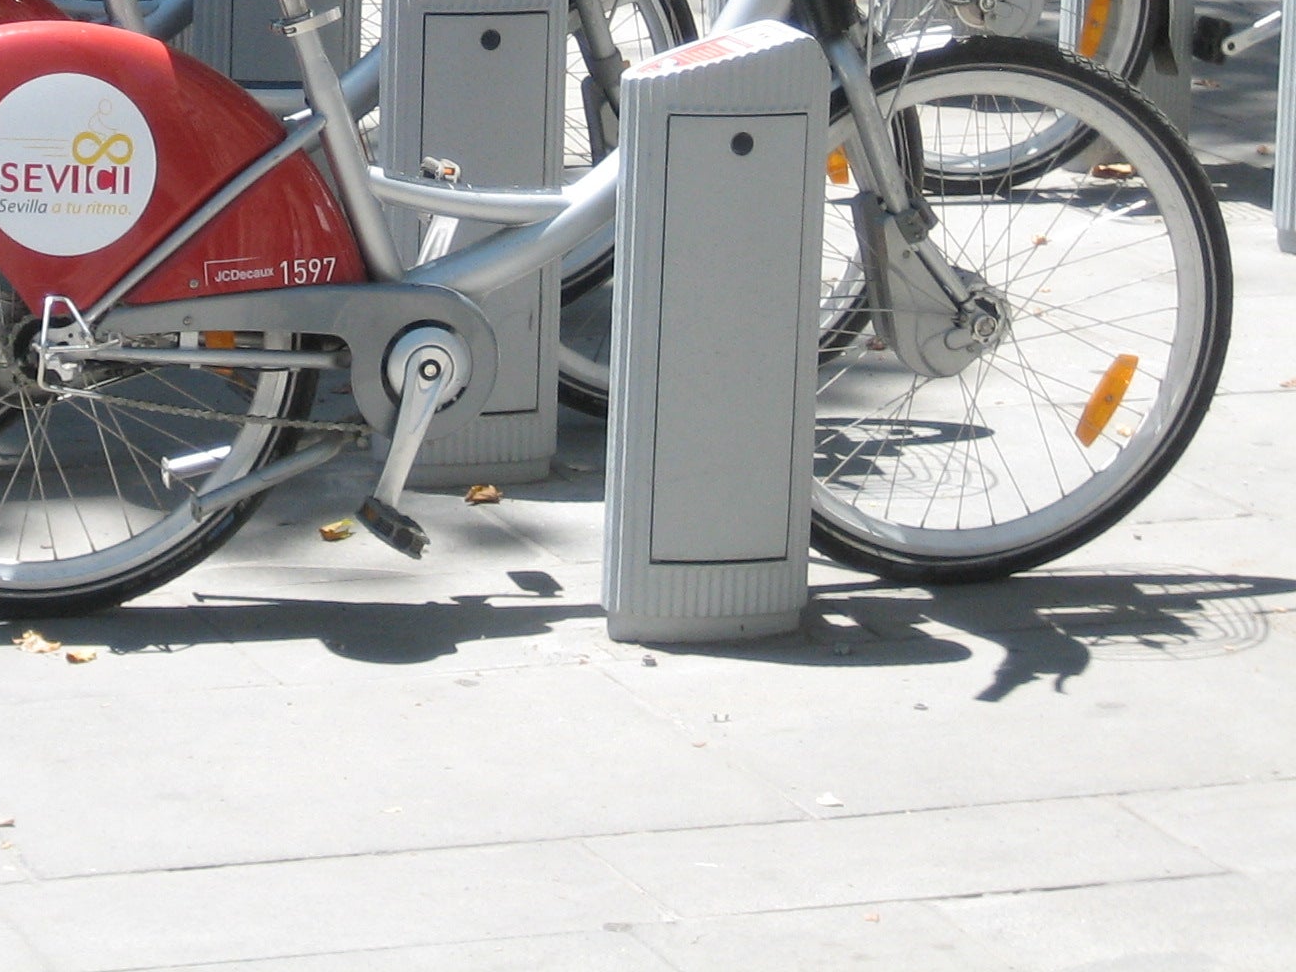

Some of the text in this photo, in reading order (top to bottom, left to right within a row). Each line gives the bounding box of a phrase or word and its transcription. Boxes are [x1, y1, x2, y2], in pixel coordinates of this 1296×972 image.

[0, 162, 130, 194] SEVICI
[51, 202, 61, 214] a
[67, 201, 81, 215] tu
[214, 257, 336, 285] JCDecaux 1597
